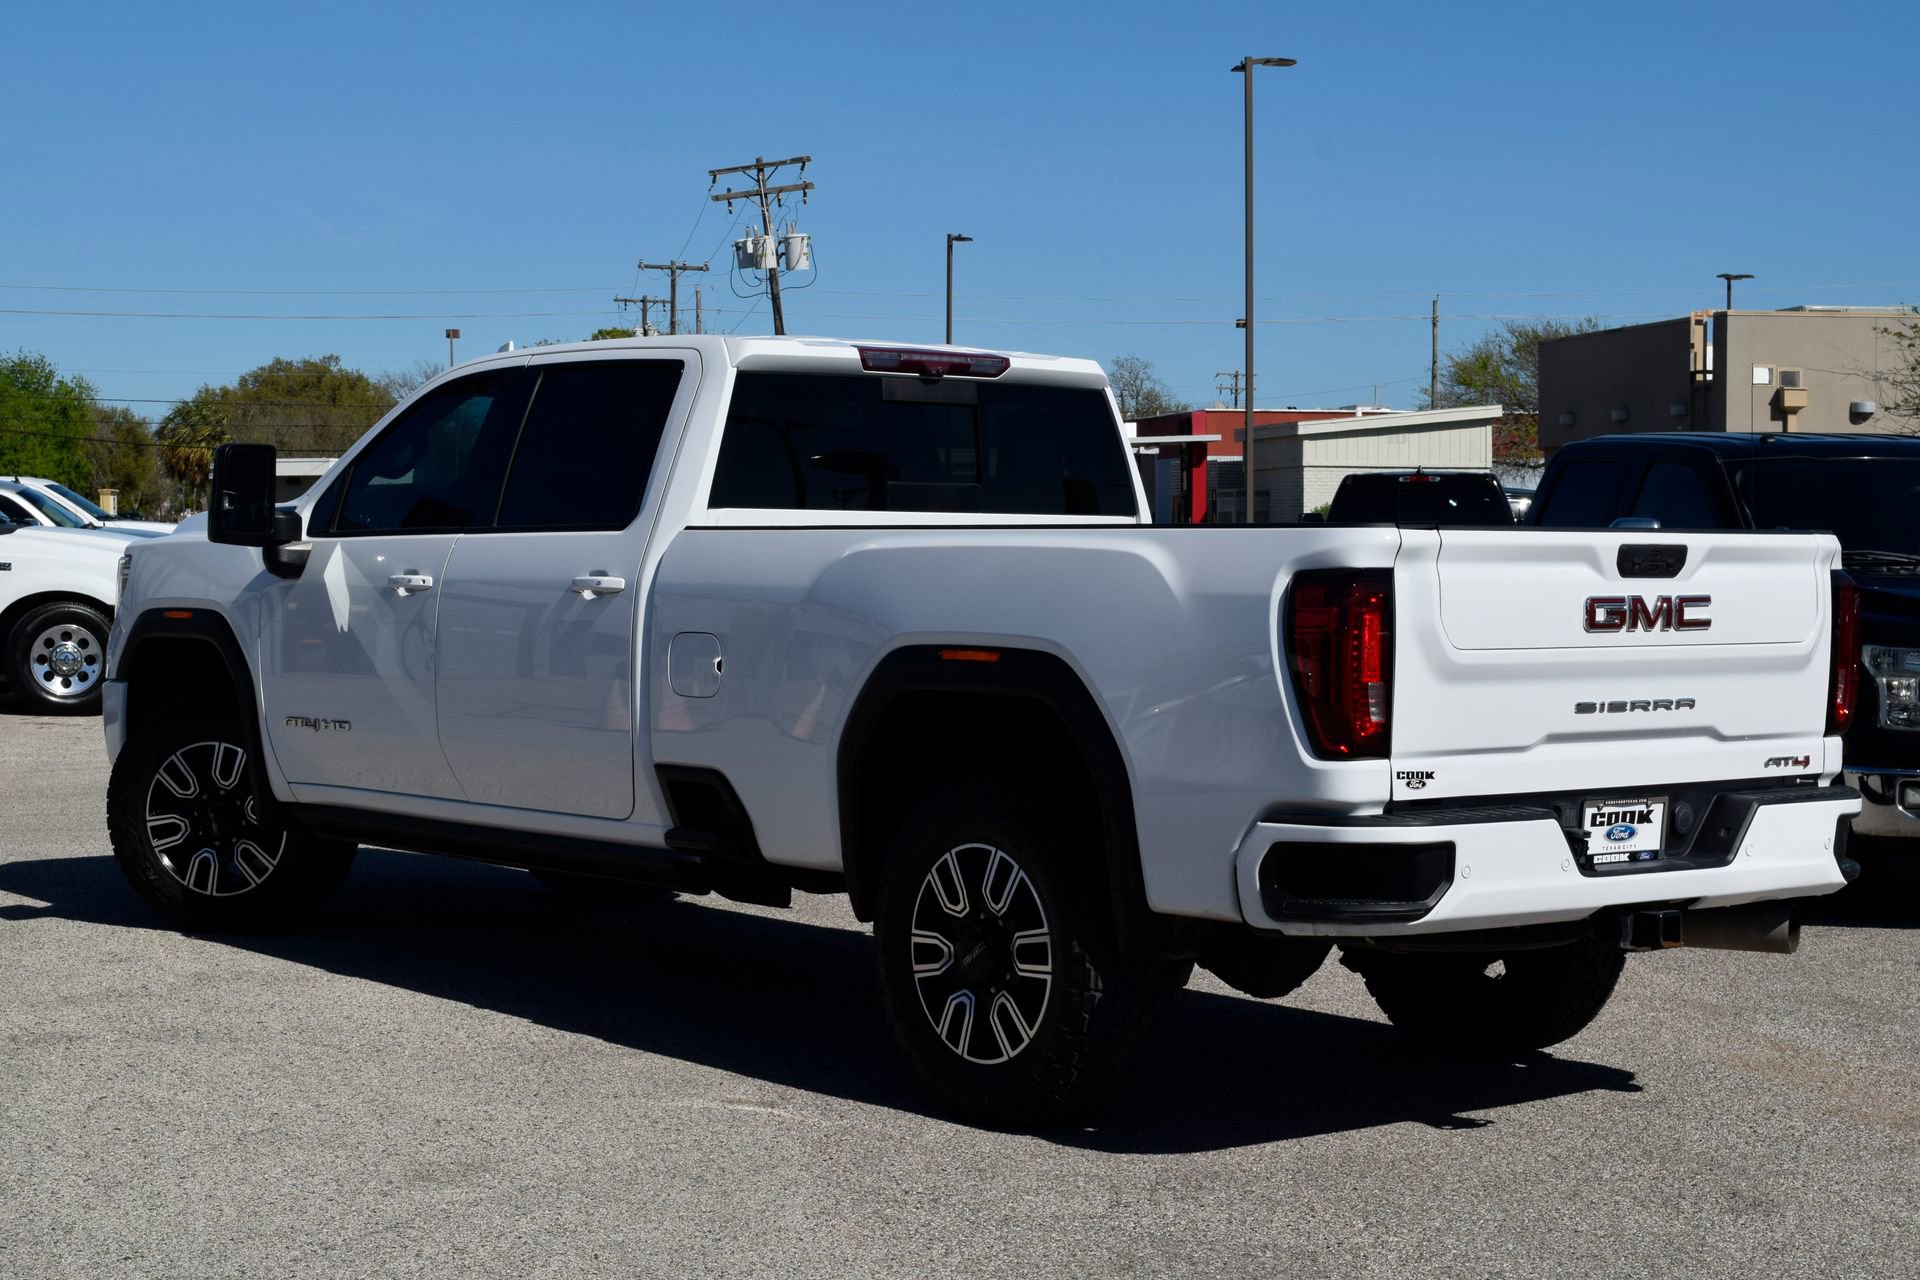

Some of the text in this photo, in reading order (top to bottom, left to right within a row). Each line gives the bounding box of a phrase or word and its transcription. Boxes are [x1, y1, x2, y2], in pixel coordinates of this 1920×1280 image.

[1583, 594, 1712, 633] GMC
[1574, 698, 1696, 714] SIERRA
[1764, 755, 1810, 770] AT4
[1396, 771, 1435, 780] COOK
[1591, 809, 1654, 827] COOK
[1609, 826, 1632, 841] Ford
[1593, 852, 1630, 864] COOK
